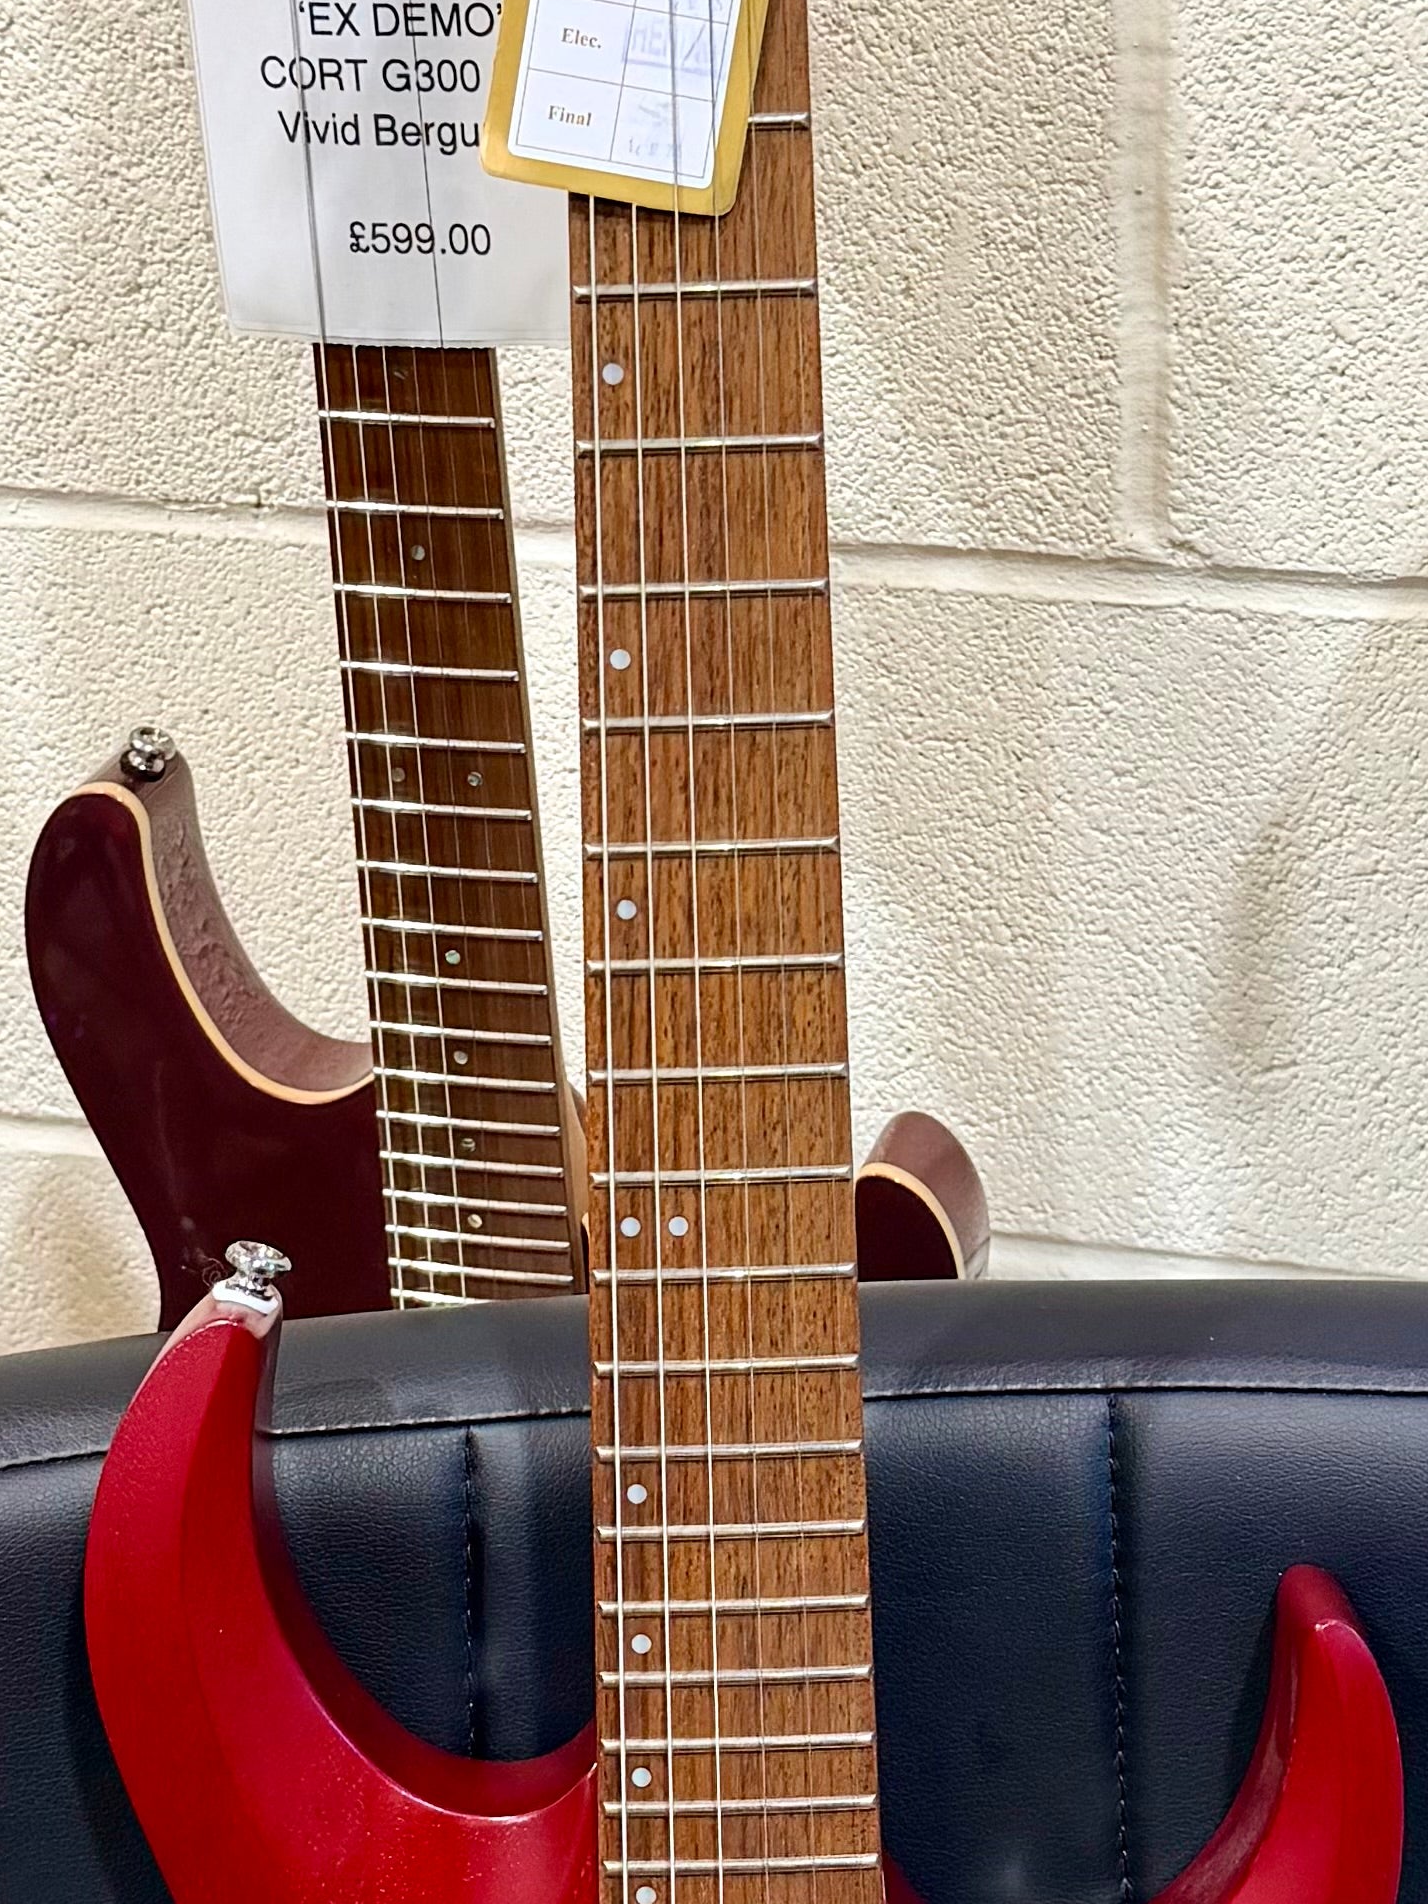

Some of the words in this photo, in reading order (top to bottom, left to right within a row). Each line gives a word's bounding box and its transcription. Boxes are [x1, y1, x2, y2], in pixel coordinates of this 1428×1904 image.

[561, 27, 602, 49] Elec.
[260, 55, 368, 92] CORT
[382, 59, 481, 93] G300
[277, 110, 361, 146] Vivid
[373, 113, 480, 156] Bergu
[548, 105, 592, 127] Final
[350, 221, 491, 255] £599.00
